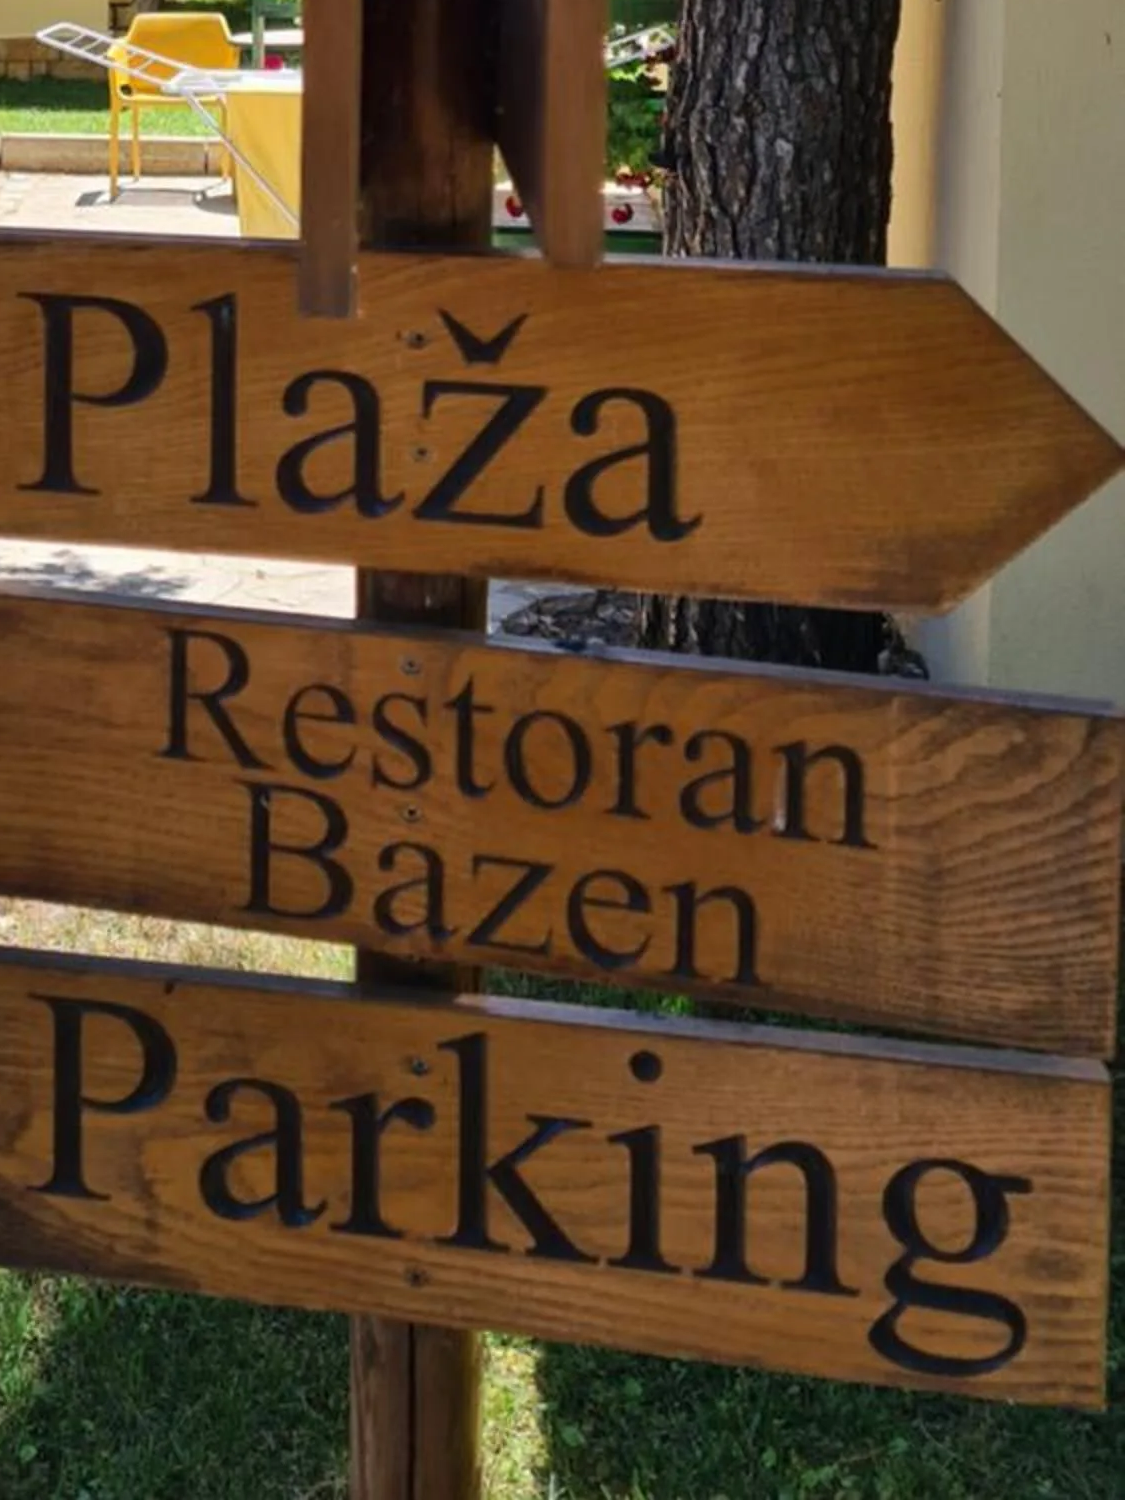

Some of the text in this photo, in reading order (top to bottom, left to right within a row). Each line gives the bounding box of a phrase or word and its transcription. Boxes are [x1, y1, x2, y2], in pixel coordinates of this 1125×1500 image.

[16, 291, 703, 542] Plaža
[161, 628, 877, 850] Restoran
[236, 780, 764, 988] Bazen
[27, 992, 1034, 1376] Parking
